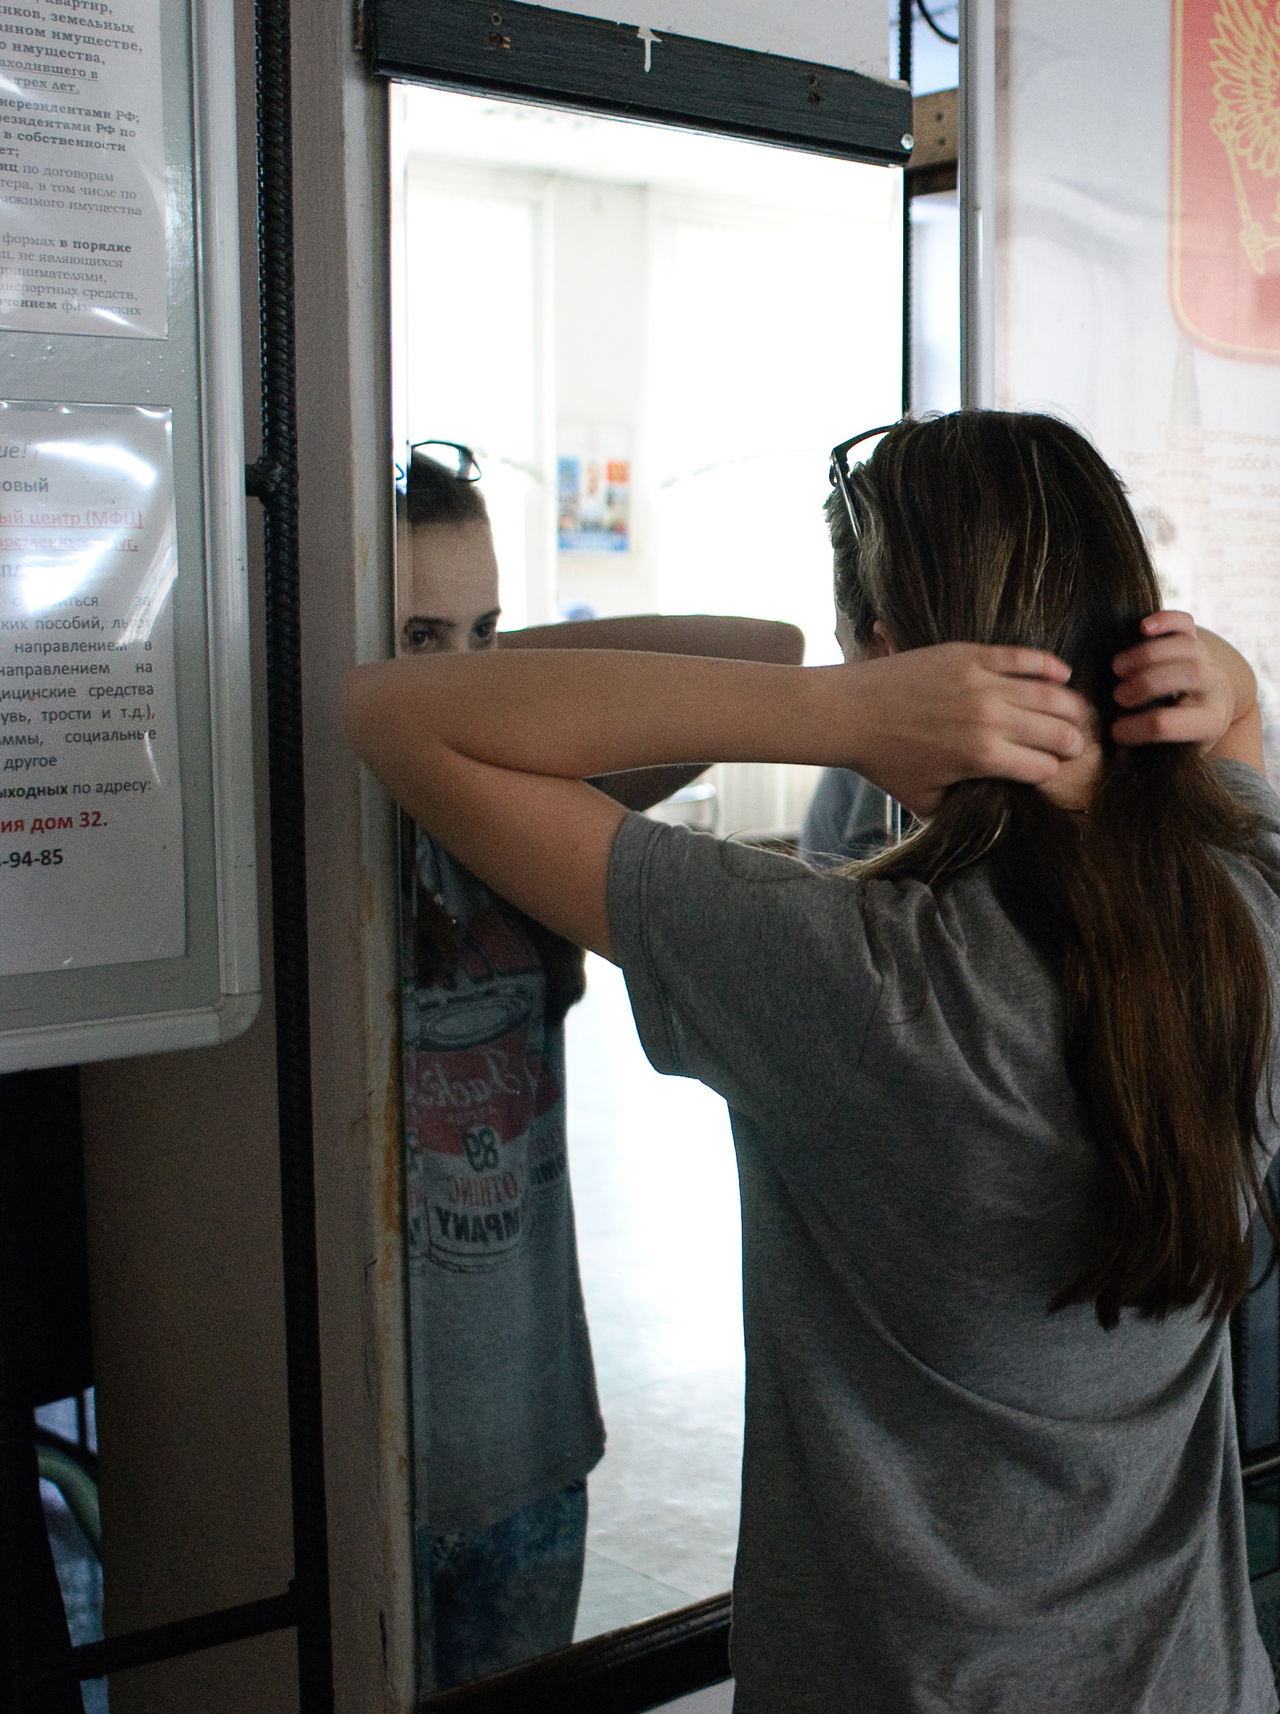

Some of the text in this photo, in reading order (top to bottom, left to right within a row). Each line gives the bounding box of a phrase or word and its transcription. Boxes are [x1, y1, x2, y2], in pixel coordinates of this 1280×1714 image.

[0, 5, 135, 34] иков, земельных
[51, 30, 144, 54] имуществе,
[12, 42, 106, 66] имущества,
[14, 77, 47, 90] трех
[90, 71, 99, 80] в
[0, 97, 141, 125] нерезидентами РФ;
[96, 123, 115, 135] РФ
[120, 128, 137, 138] по
[3, 131, 127, 153] в собственности
[23, 164, 39, 175] по
[43, 167, 114, 183] договорам
[38, 182, 47, 191] в
[50, 184, 75, 194] том
[80, 187, 117, 199] числе
[120, 190, 137, 200] по
[69, 201, 143, 217] имущества
[2, 232, 132, 254] формах в порядке
[19, 252, 35, 262] не
[38, 255, 123, 269] являющихся
[82, 289, 138, 303] средств,
[0, 477, 49, 493] овый
[30, 513, 81, 526] центр
[0, 618, 28, 631] ких
[36, 616, 104, 632] пособий,
[14, 640, 153, 657] направлением в
[136, 662, 153, 674] на
[0, 685, 154, 703] ицинские средства
[41, 710, 92, 725] трости
[101, 709, 111, 720] и
[0, 735, 44, 747] ммы,
[4, 756, 58, 772] другое
[72, 785, 91, 796] по
[95, 779, 152, 796] адресу:
[30, 815, 74, 836] дом
[79, 810, 108, 829] 32.
[0, 848, 64, 869] -94-85
